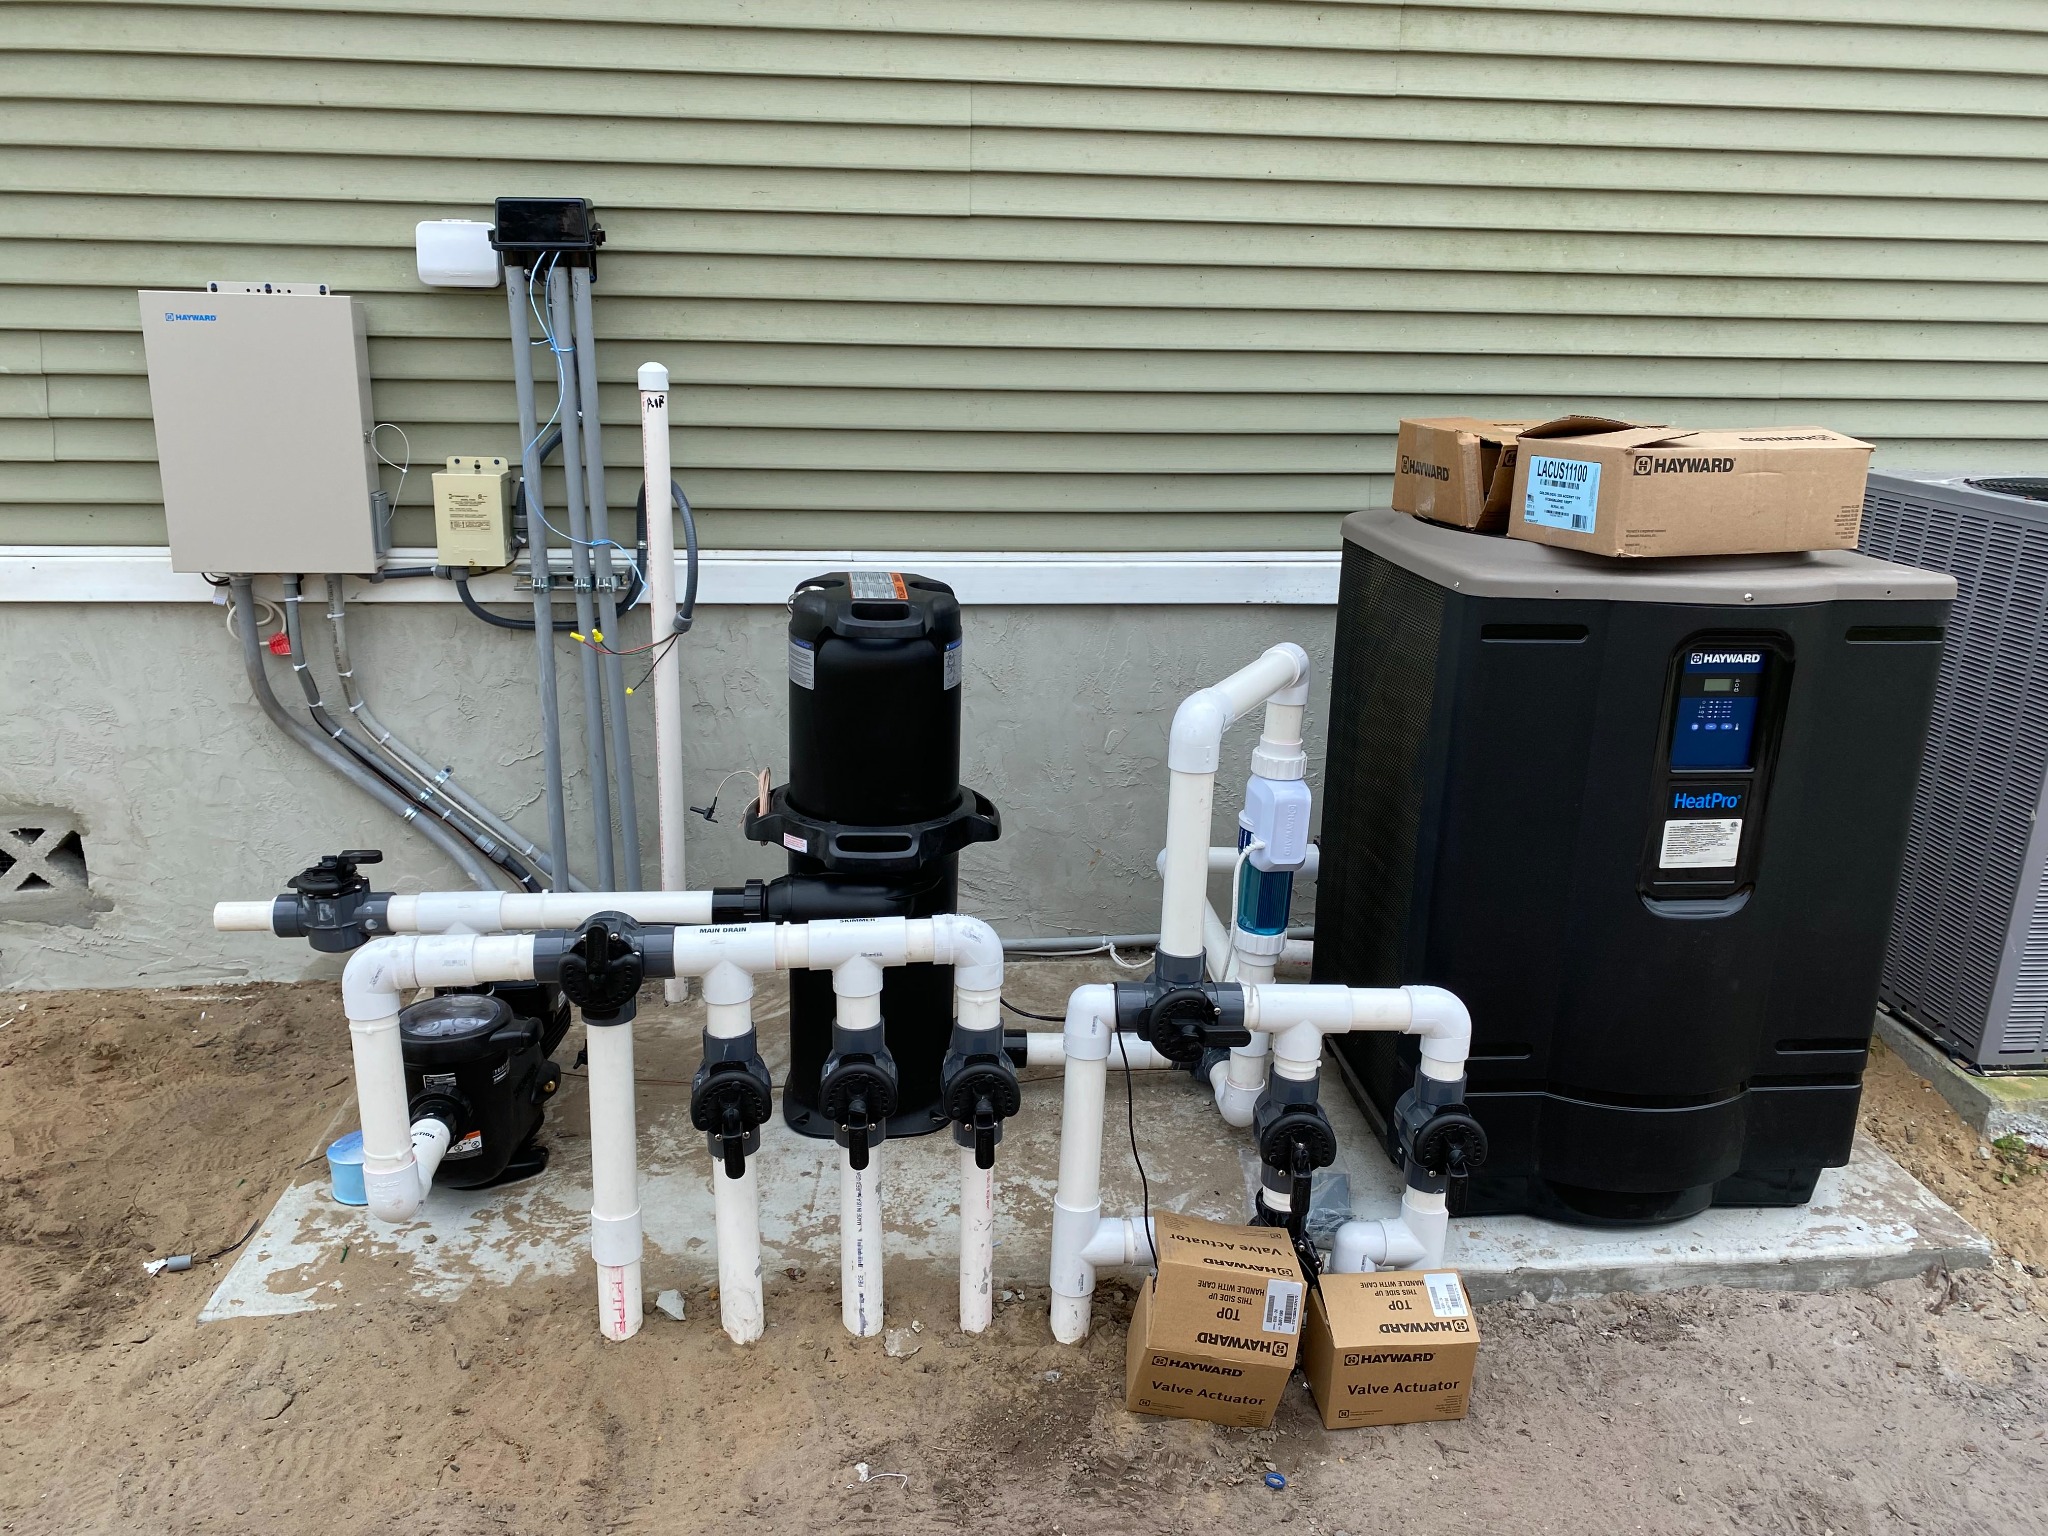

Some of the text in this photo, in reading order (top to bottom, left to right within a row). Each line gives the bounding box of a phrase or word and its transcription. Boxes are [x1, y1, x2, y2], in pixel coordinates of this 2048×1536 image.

[646, 394, 665, 412] AIR
[1409, 459, 1450, 481] HAYWARD
[1537, 460, 1588, 482] LACUS11100
[1653, 457, 1734, 473] HAYWARD
[1703, 654, 1761, 664] HAYWARD
[1674, 792, 1738, 809] HeatPro
[1169, 1233, 1235, 1249] Actuator
[1239, 1244, 1282, 1256] Valve
[1202, 1257, 1277, 1274] HAYWARD
[1197, 1279, 1265, 1296] HANDLE WITH CARE
[1379, 1280, 1397, 1288] WITH
[1398, 1279, 1425, 1287] HANDLE
[1208, 1292, 1253, 1305] THIS SIDE UP
[1388, 1300, 1412, 1310] TOP
[1216, 1307, 1241, 1321] TOP
[1379, 1321, 1453, 1333] HAYWARD
[1197, 1331, 1272, 1353] HAYWARD
[1361, 1352, 1434, 1364] HAYWARD
[1168, 1359, 1243, 1377] HAYWARD
[1151, 1380, 1194, 1395] Valve
[1196, 1388, 1266, 1406] Actuator
[1347, 1380, 1460, 1396] Valve Actuator
